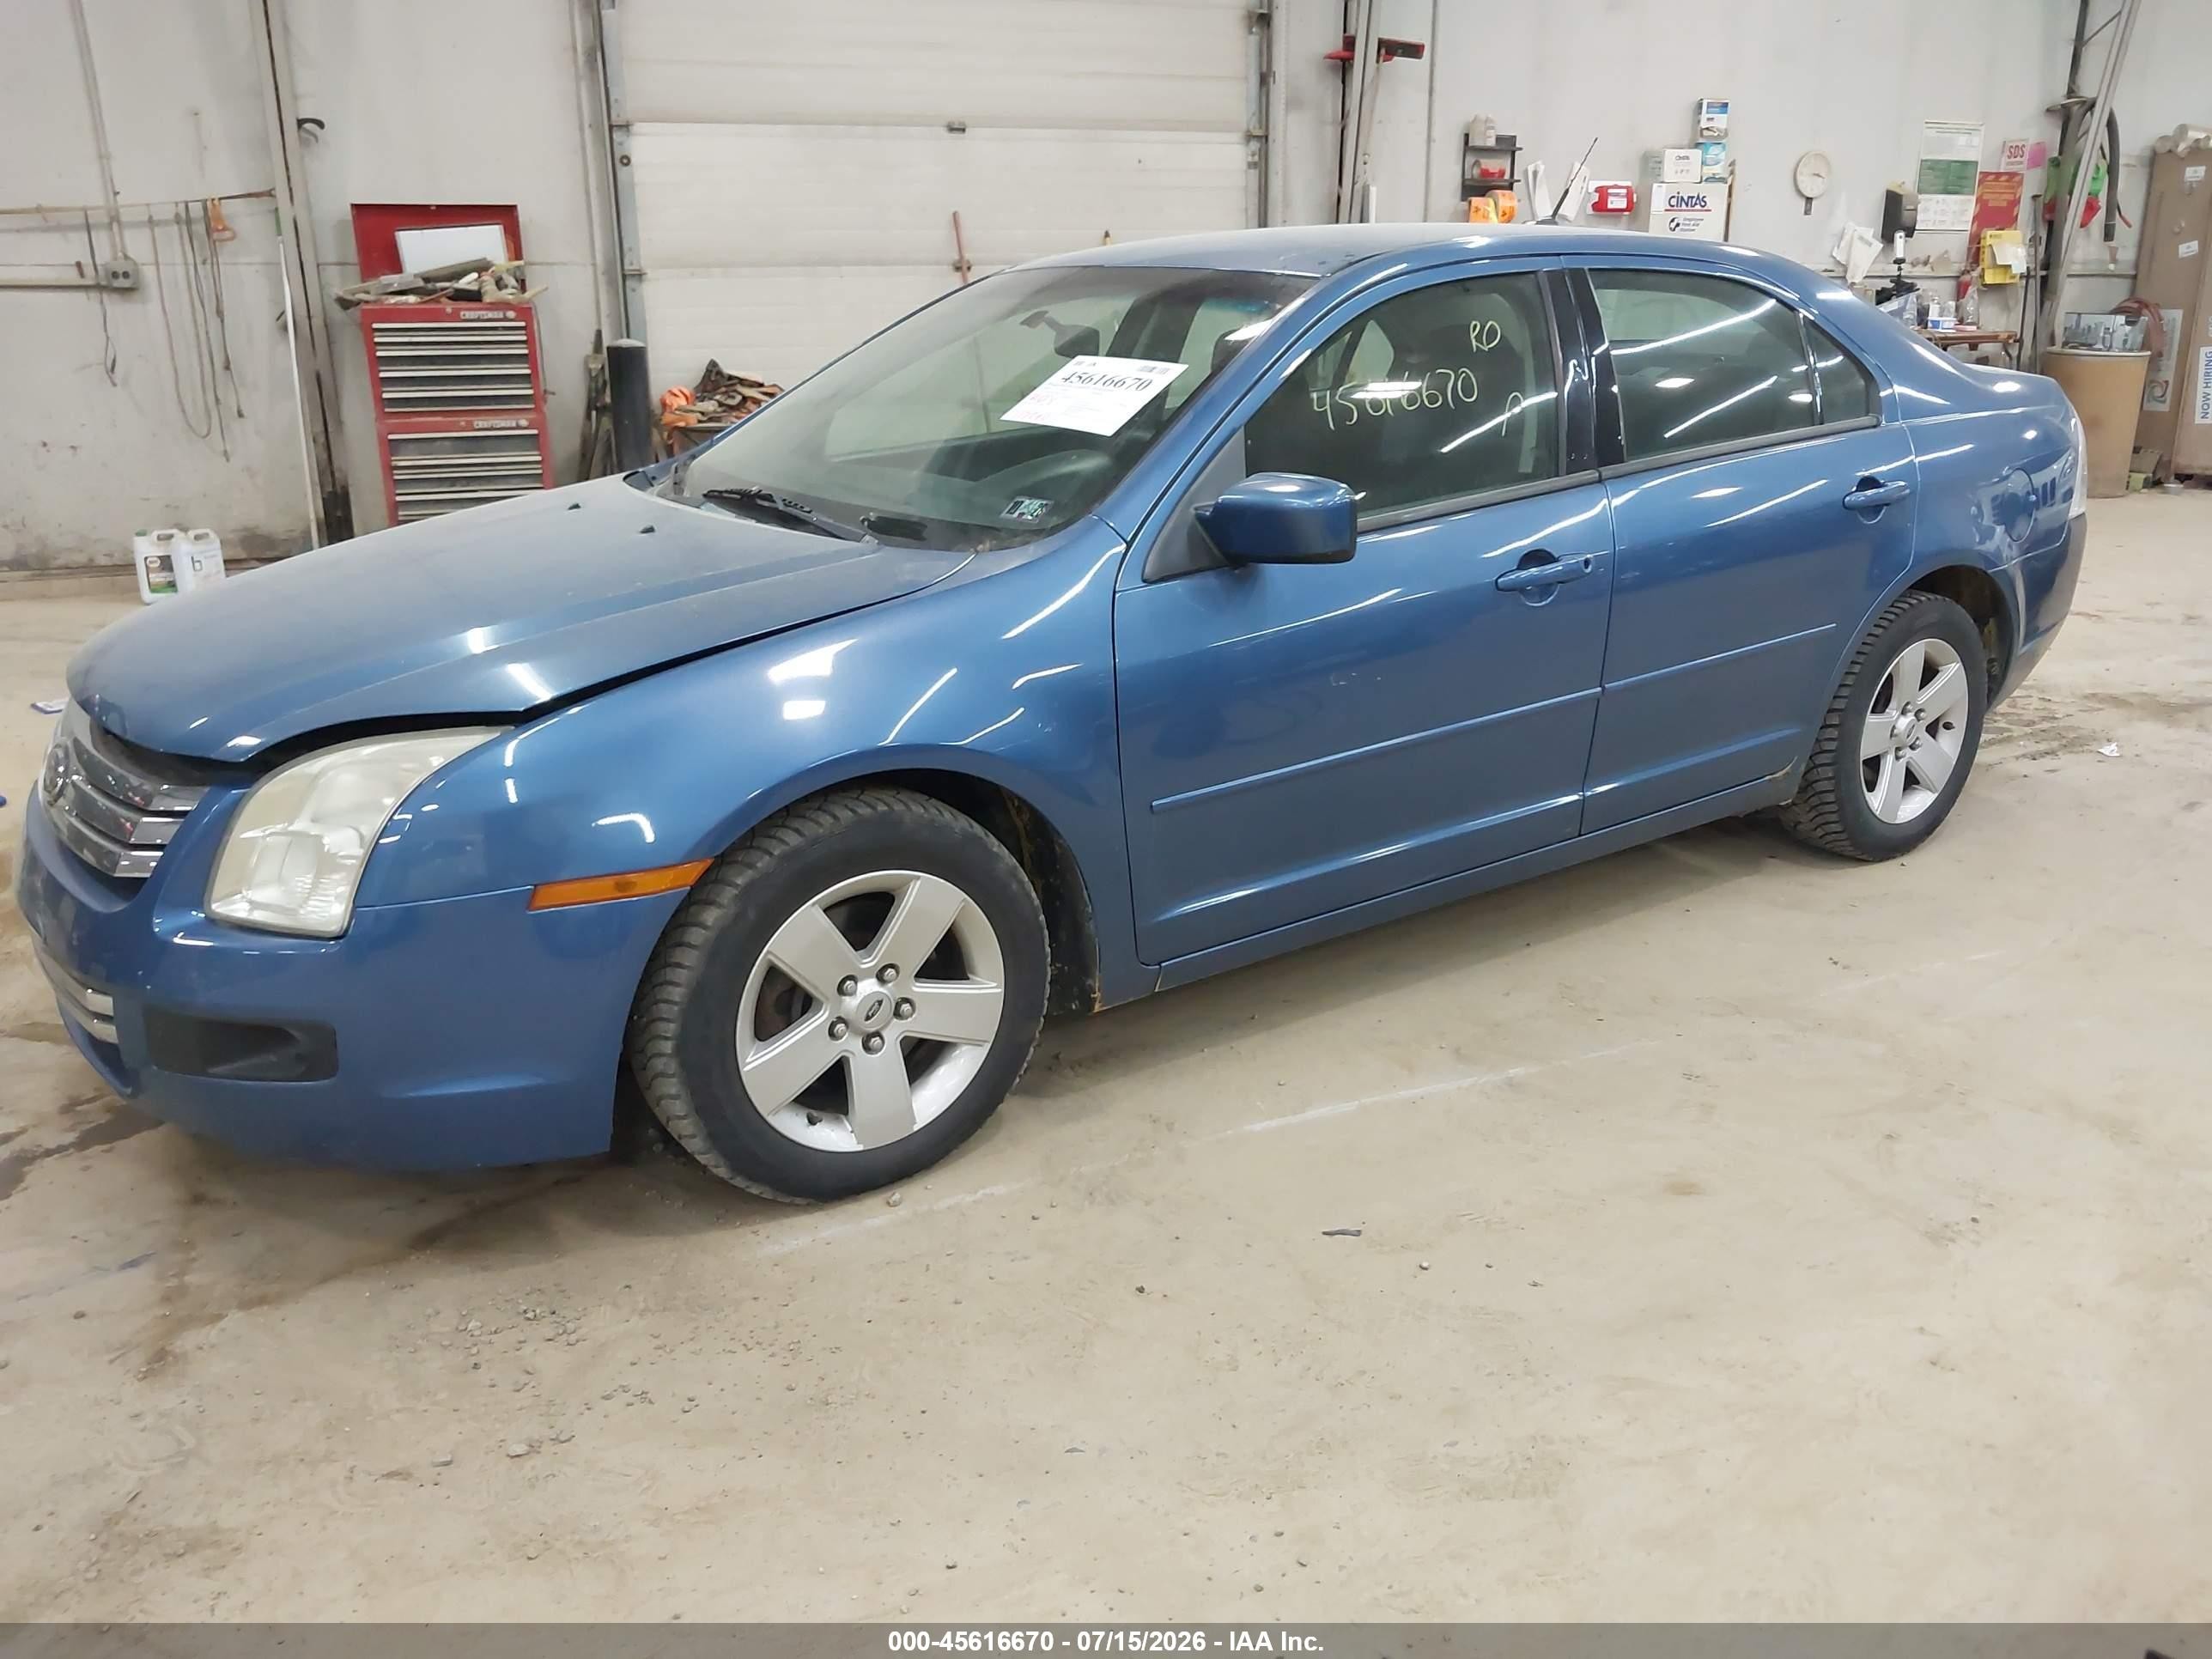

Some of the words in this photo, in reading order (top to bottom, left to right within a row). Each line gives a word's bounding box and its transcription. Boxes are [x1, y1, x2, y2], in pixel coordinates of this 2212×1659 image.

[2007, 143, 2026, 160] SDS
[1668, 191, 1708, 208] CINTAS
[2202, 350, 2212, 390] HIRING
[1061, 371, 1154, 392] 45616670
[2200, 391, 2212, 420] NOW
